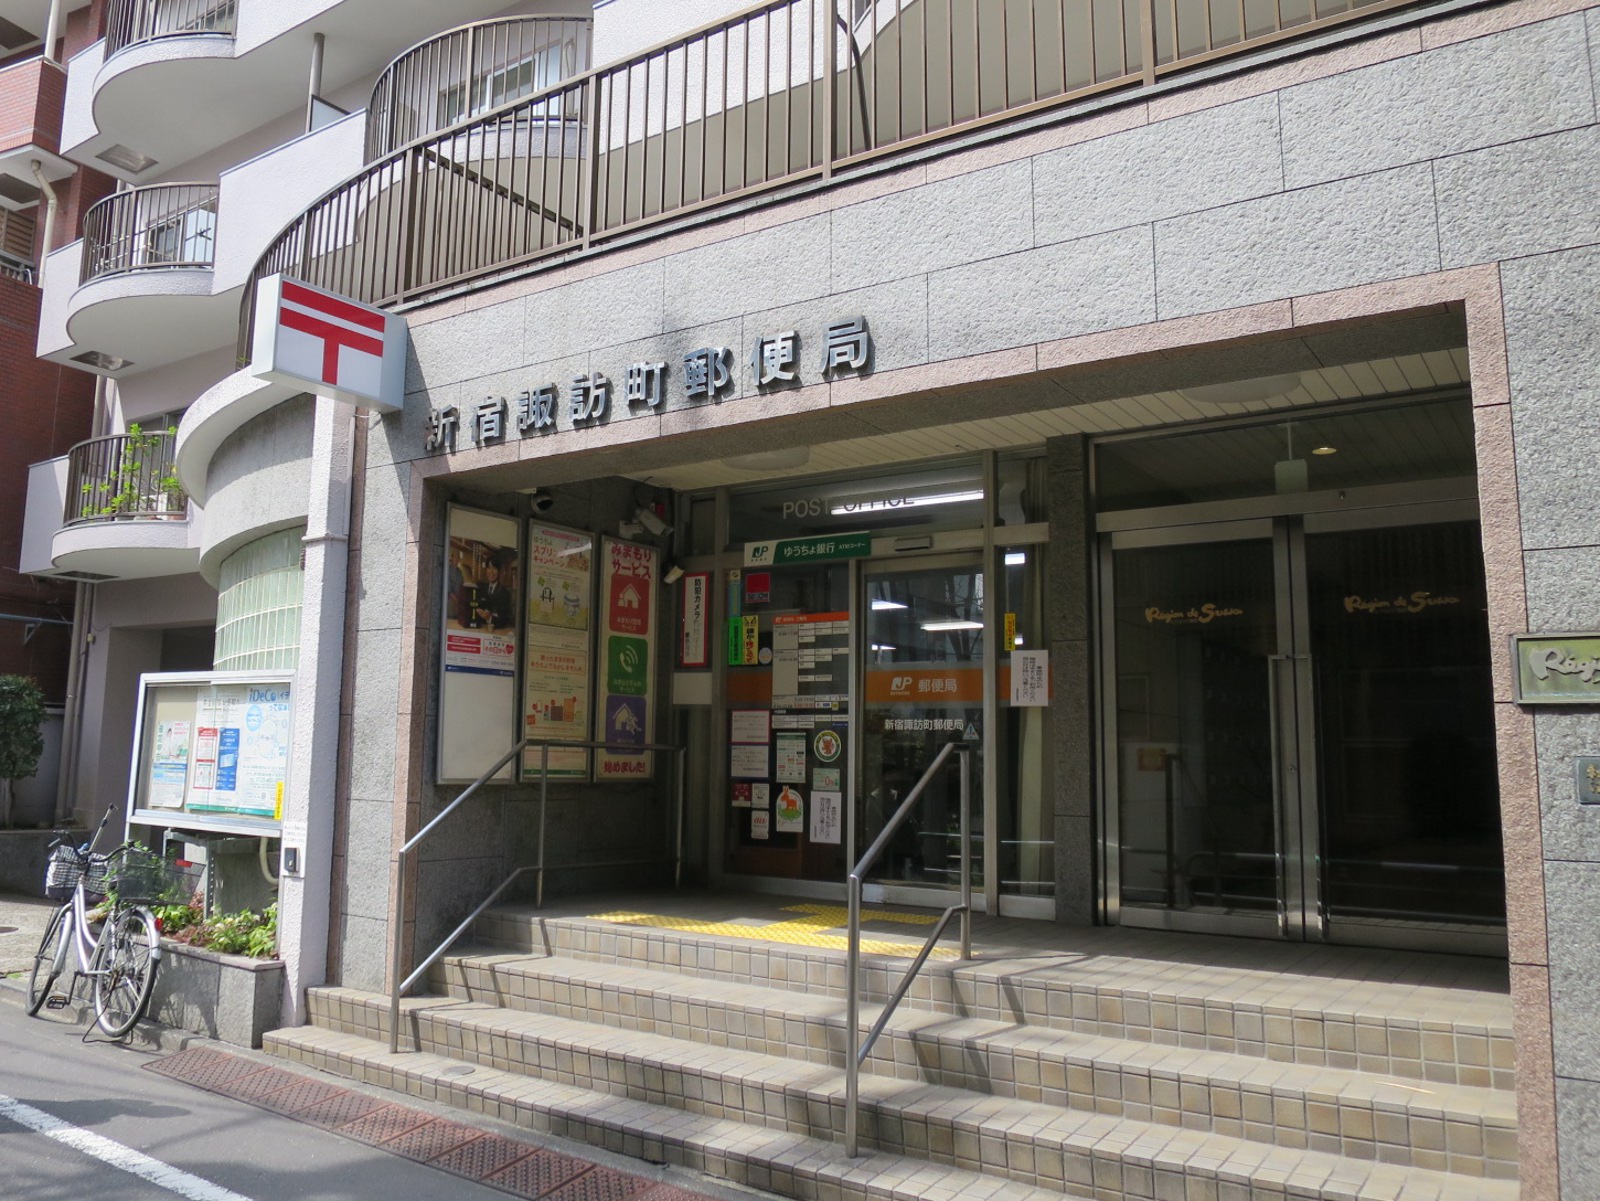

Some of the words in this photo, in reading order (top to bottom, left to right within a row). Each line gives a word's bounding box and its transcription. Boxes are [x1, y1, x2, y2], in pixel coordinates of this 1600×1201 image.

[424, 315, 870, 451] 新宿諏訪町郵便局
[783, 498, 830, 520] POST
[611, 543, 651, 562] みまもり
[784, 542, 836, 557] ゆうちょ銀行
[612, 559, 651, 579] サービス
[918, 678, 957, 693] 郵便局
[884, 719, 964, 731] 新宿諏訪町郵便局
